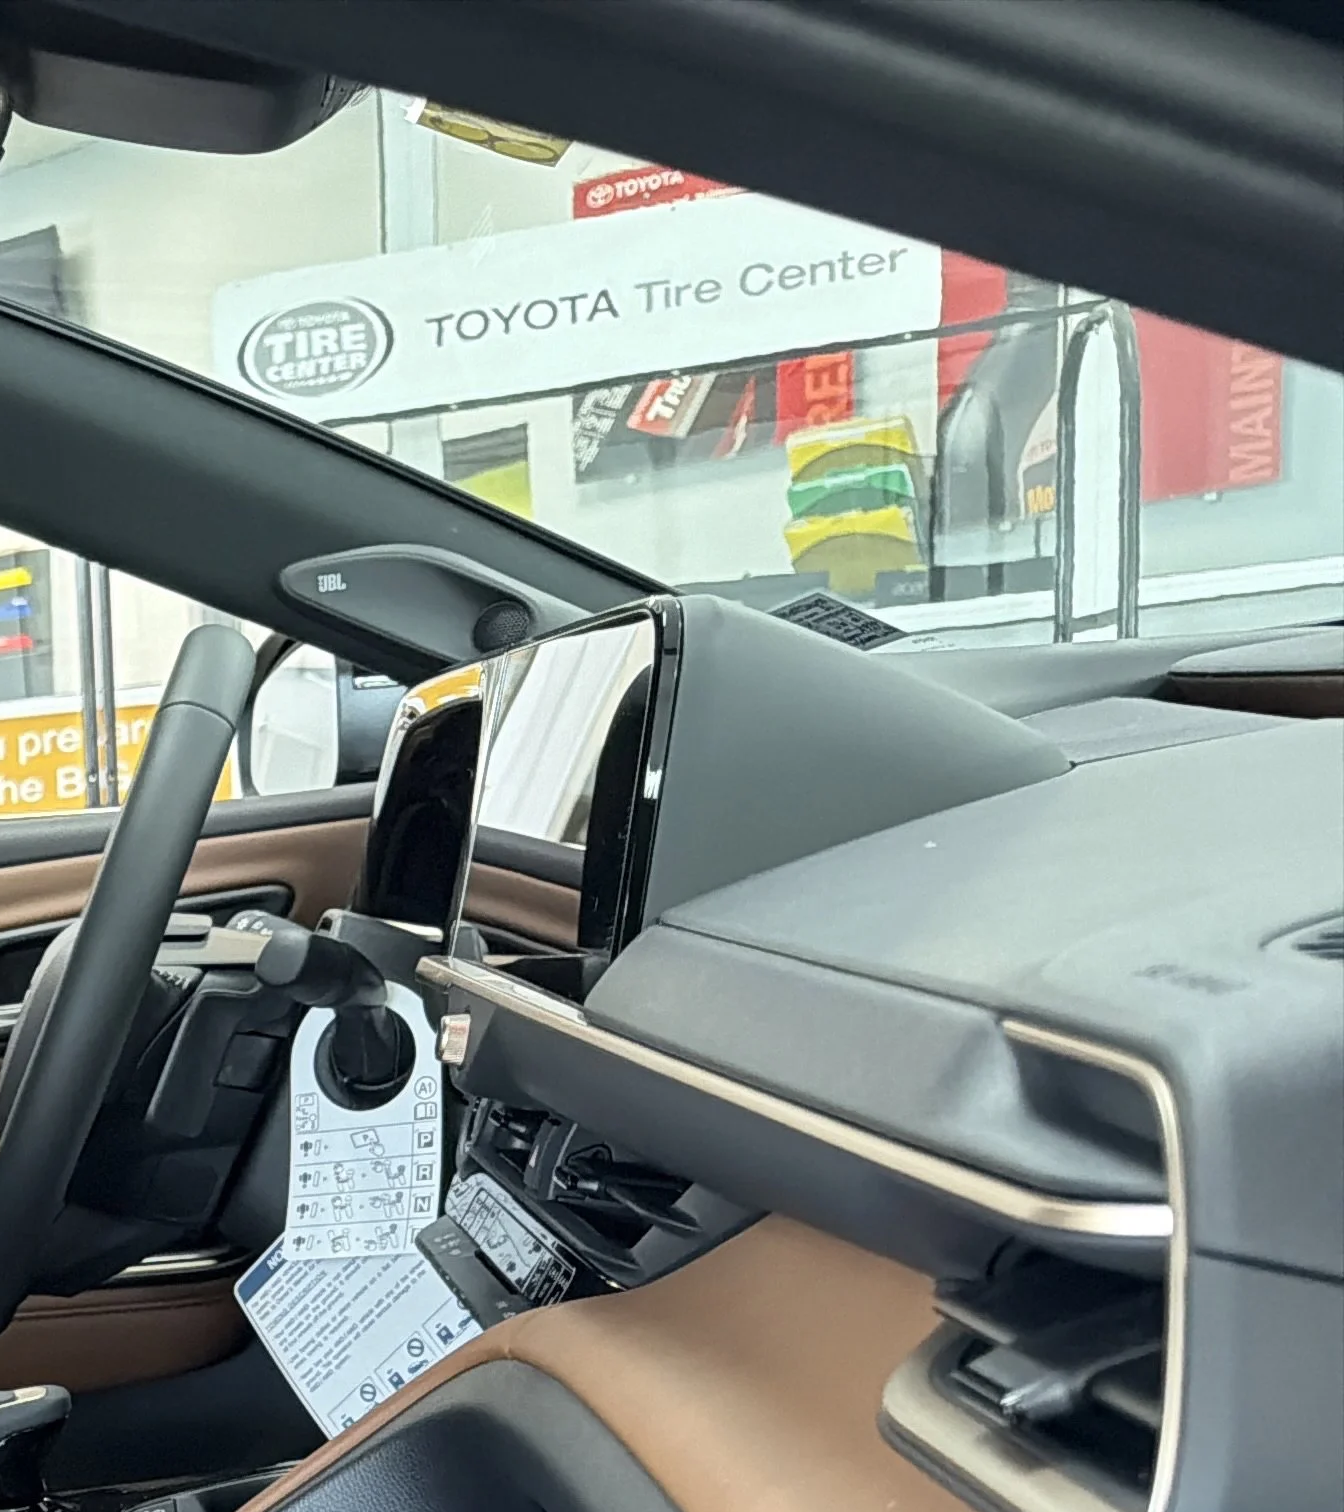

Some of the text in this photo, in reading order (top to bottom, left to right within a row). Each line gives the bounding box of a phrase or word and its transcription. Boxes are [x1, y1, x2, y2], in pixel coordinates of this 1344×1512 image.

[614, 170, 684, 198] TOYOTA
[426, 247, 908, 348] TOYOTA Tire Center
[263, 323, 368, 363] TIRE
[265, 352, 368, 383] CENTER
[318, 573, 347, 592] JBL
[418, 1083, 432, 1095] A1
[420, 1133, 431, 1147] P
[419, 1166, 431, 1180] R
[417, 1198, 429, 1211] N
